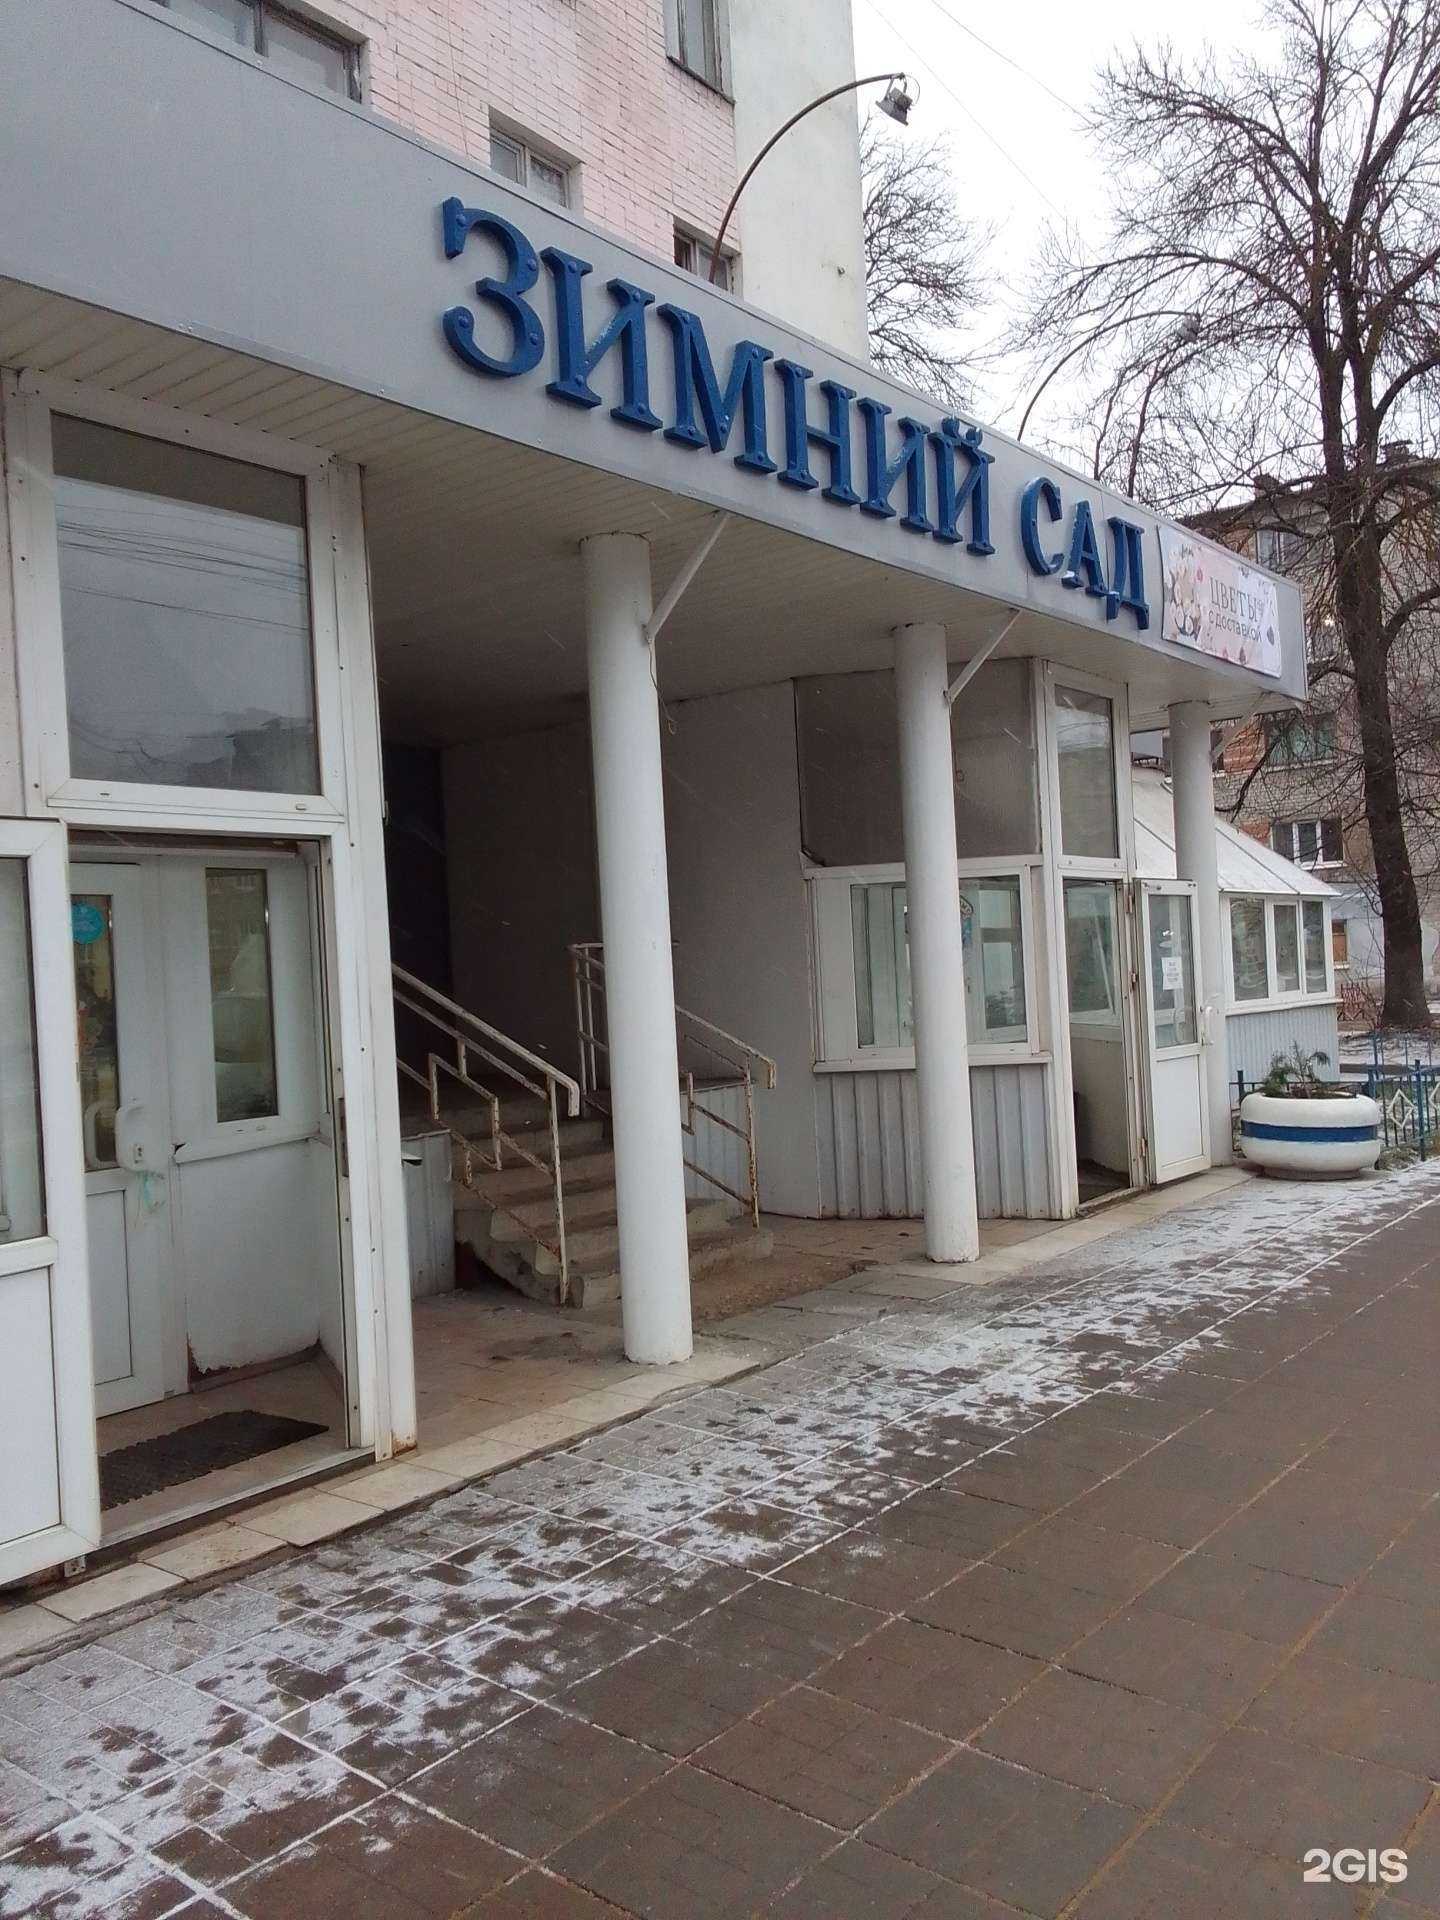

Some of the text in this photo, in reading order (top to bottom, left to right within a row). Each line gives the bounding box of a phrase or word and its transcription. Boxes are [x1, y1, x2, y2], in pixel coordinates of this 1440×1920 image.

[442, 196, 1149, 630] ЗИМНИЙ САД
[1210, 576, 1258, 623] ЦВЕТЫ
